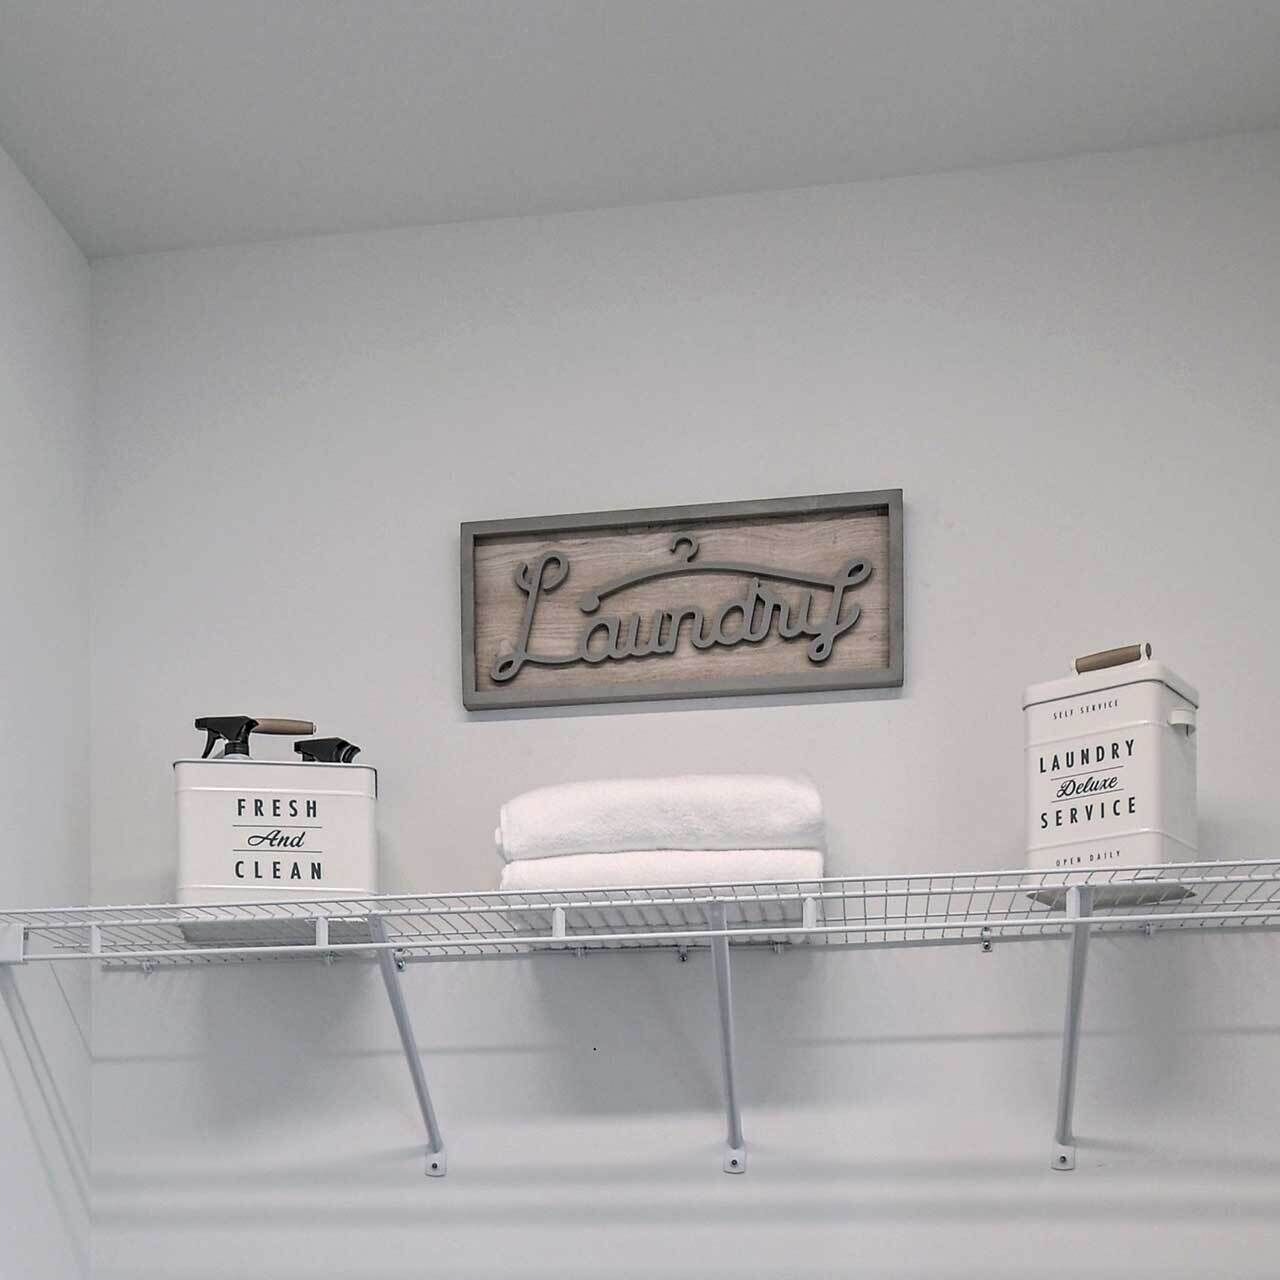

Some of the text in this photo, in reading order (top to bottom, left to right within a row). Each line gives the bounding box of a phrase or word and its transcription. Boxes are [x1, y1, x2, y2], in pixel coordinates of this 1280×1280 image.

[490, 551, 873, 682] Laundry
[1053, 699, 1118, 720] SELF SERVICE
[1040, 739, 1135, 773] LAUNDRY
[1056, 776, 1118, 798] Deluxe
[237, 798, 317, 818] FRESH
[1041, 797, 1136, 829] SERVICE
[247, 829, 306, 848] And
[1056, 850, 1120, 867] OPEN DAILY
[235, 860, 322, 880] CLEAN
